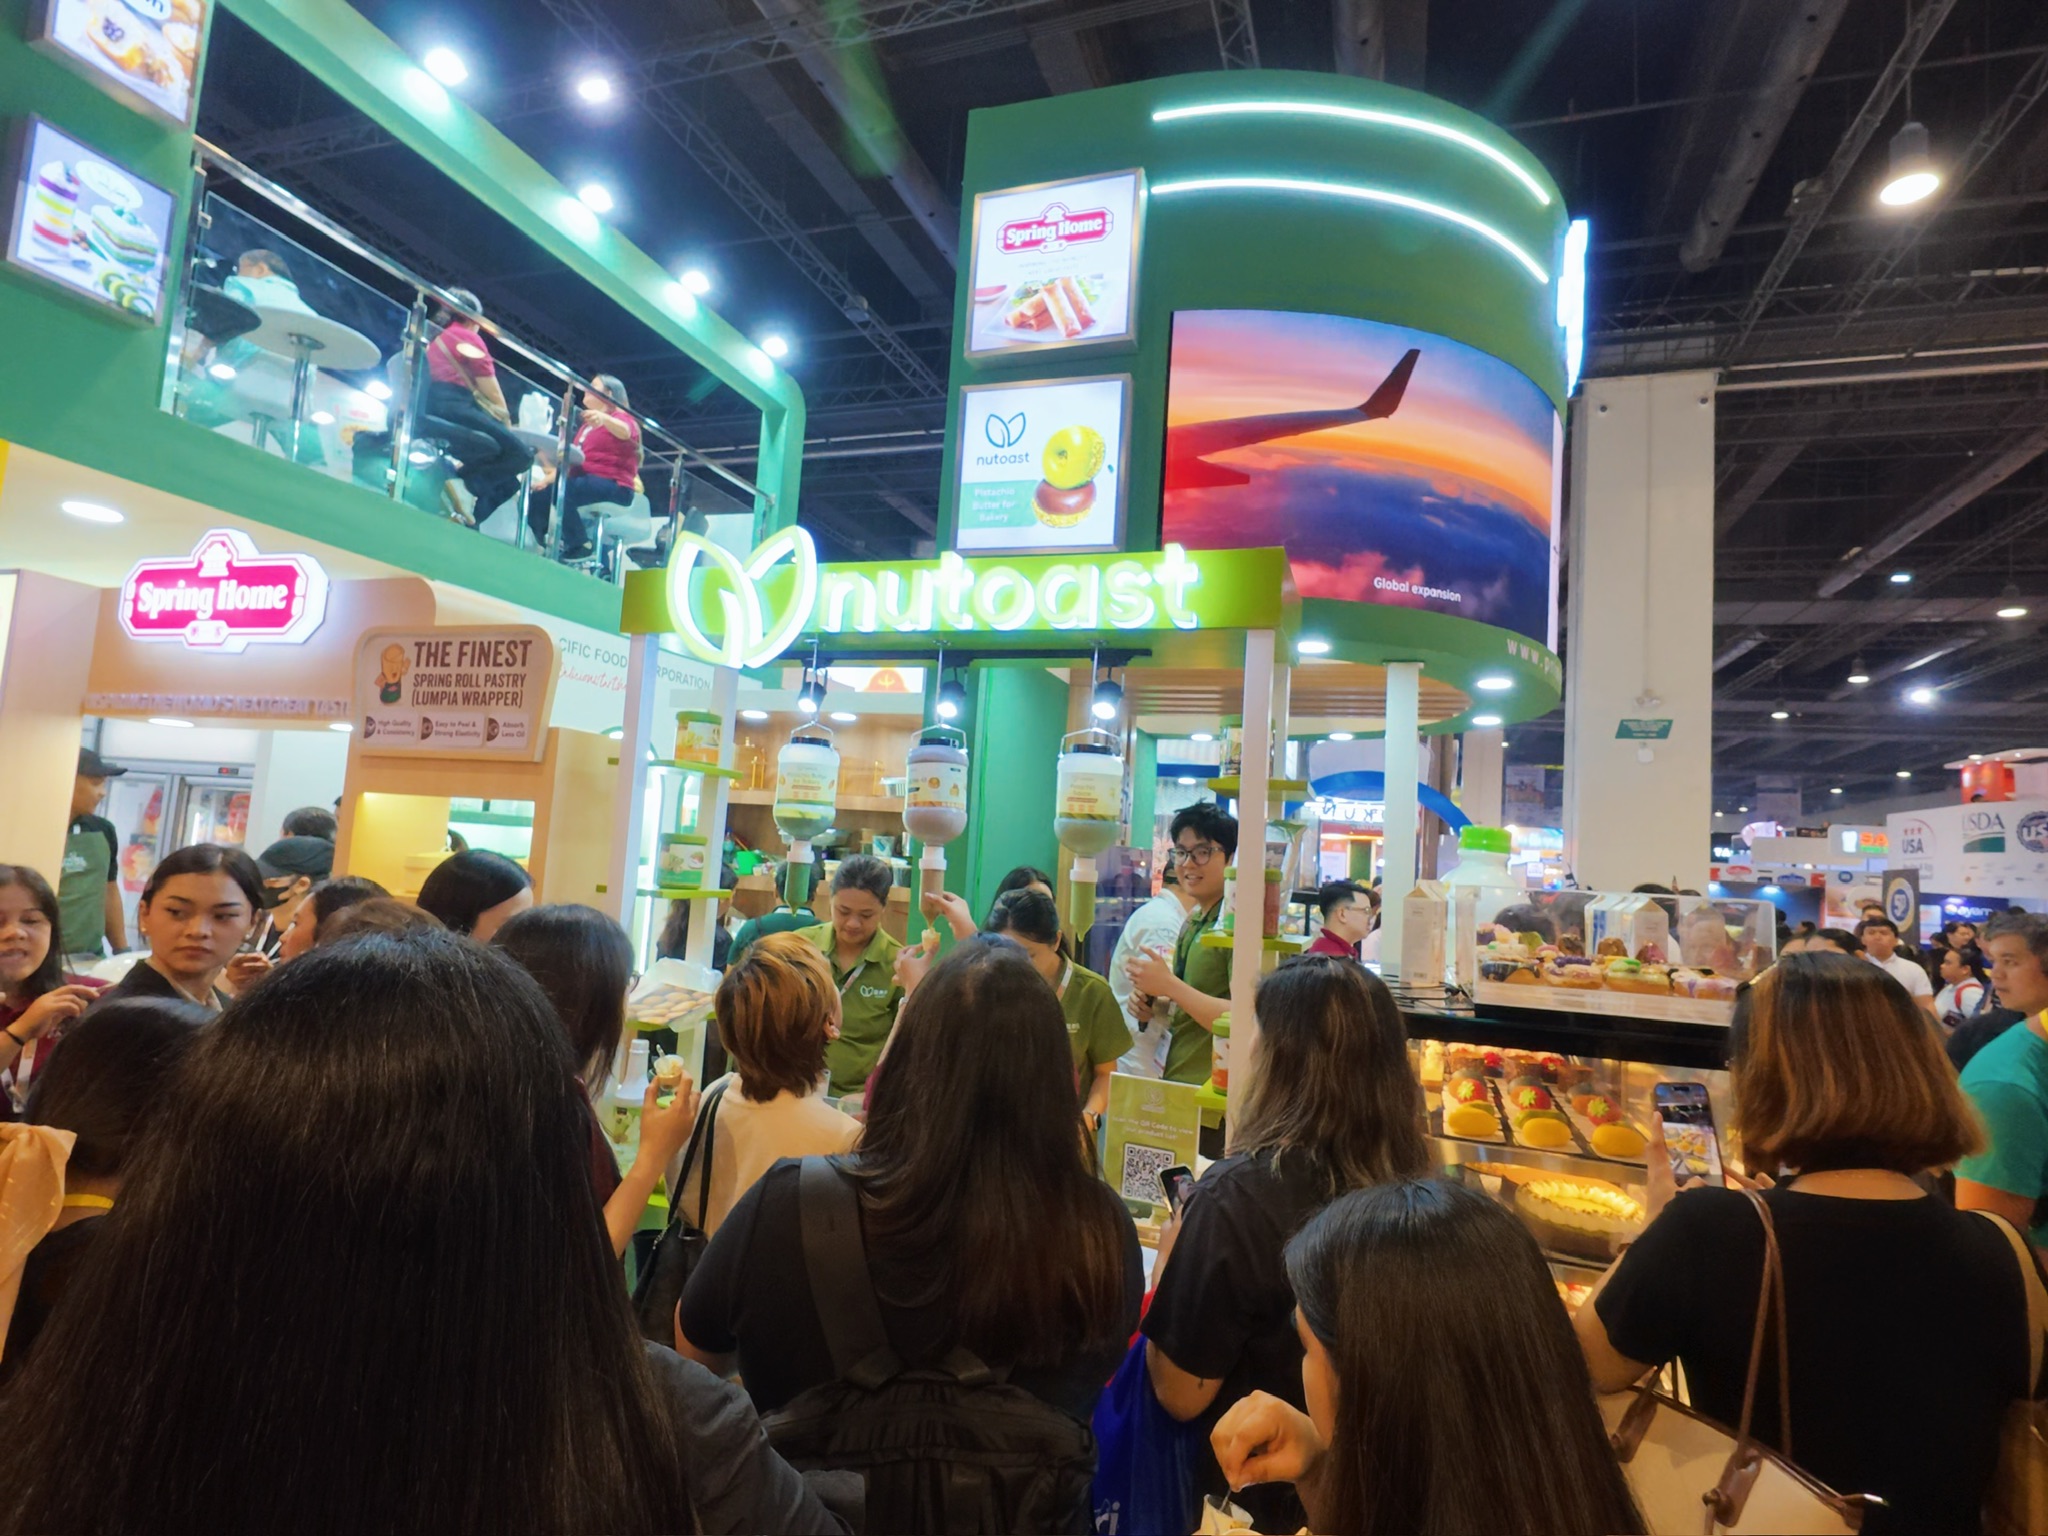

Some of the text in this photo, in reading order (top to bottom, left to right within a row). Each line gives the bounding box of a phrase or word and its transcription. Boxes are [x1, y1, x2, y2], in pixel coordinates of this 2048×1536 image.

[1006, 217, 1103, 246] Spring Home
[976, 452, 1030, 466] nutoast
[974, 488, 1016, 497] Pistachio
[972, 500, 1015, 511] Butter for
[979, 513, 1009, 523] Bakery
[820, 543, 1199, 632] nutoast
[1373, 577, 1461, 602] Global expansion
[138, 579, 289, 620] Spring Home
[414, 639, 533, 668] THE FINEST
[413, 673, 527, 689] SPRING ROLL PASTRY
[411, 688, 523, 709] (LUMPIA WRAPPER)
[435, 720, 448, 729] Easy
[450, 720, 456, 728] to
[457, 720, 471, 728] Peel
[502, 721, 524, 729] Absorb
[434, 730, 481, 738] Strong Elasticity
[501, 730, 514, 738] Less
[1962, 812, 2005, 831] USDA
[1902, 838, 1924, 854] USA
[1138, 1128, 1164, 1138] product
[1151, 1122, 1169, 1132] Code
